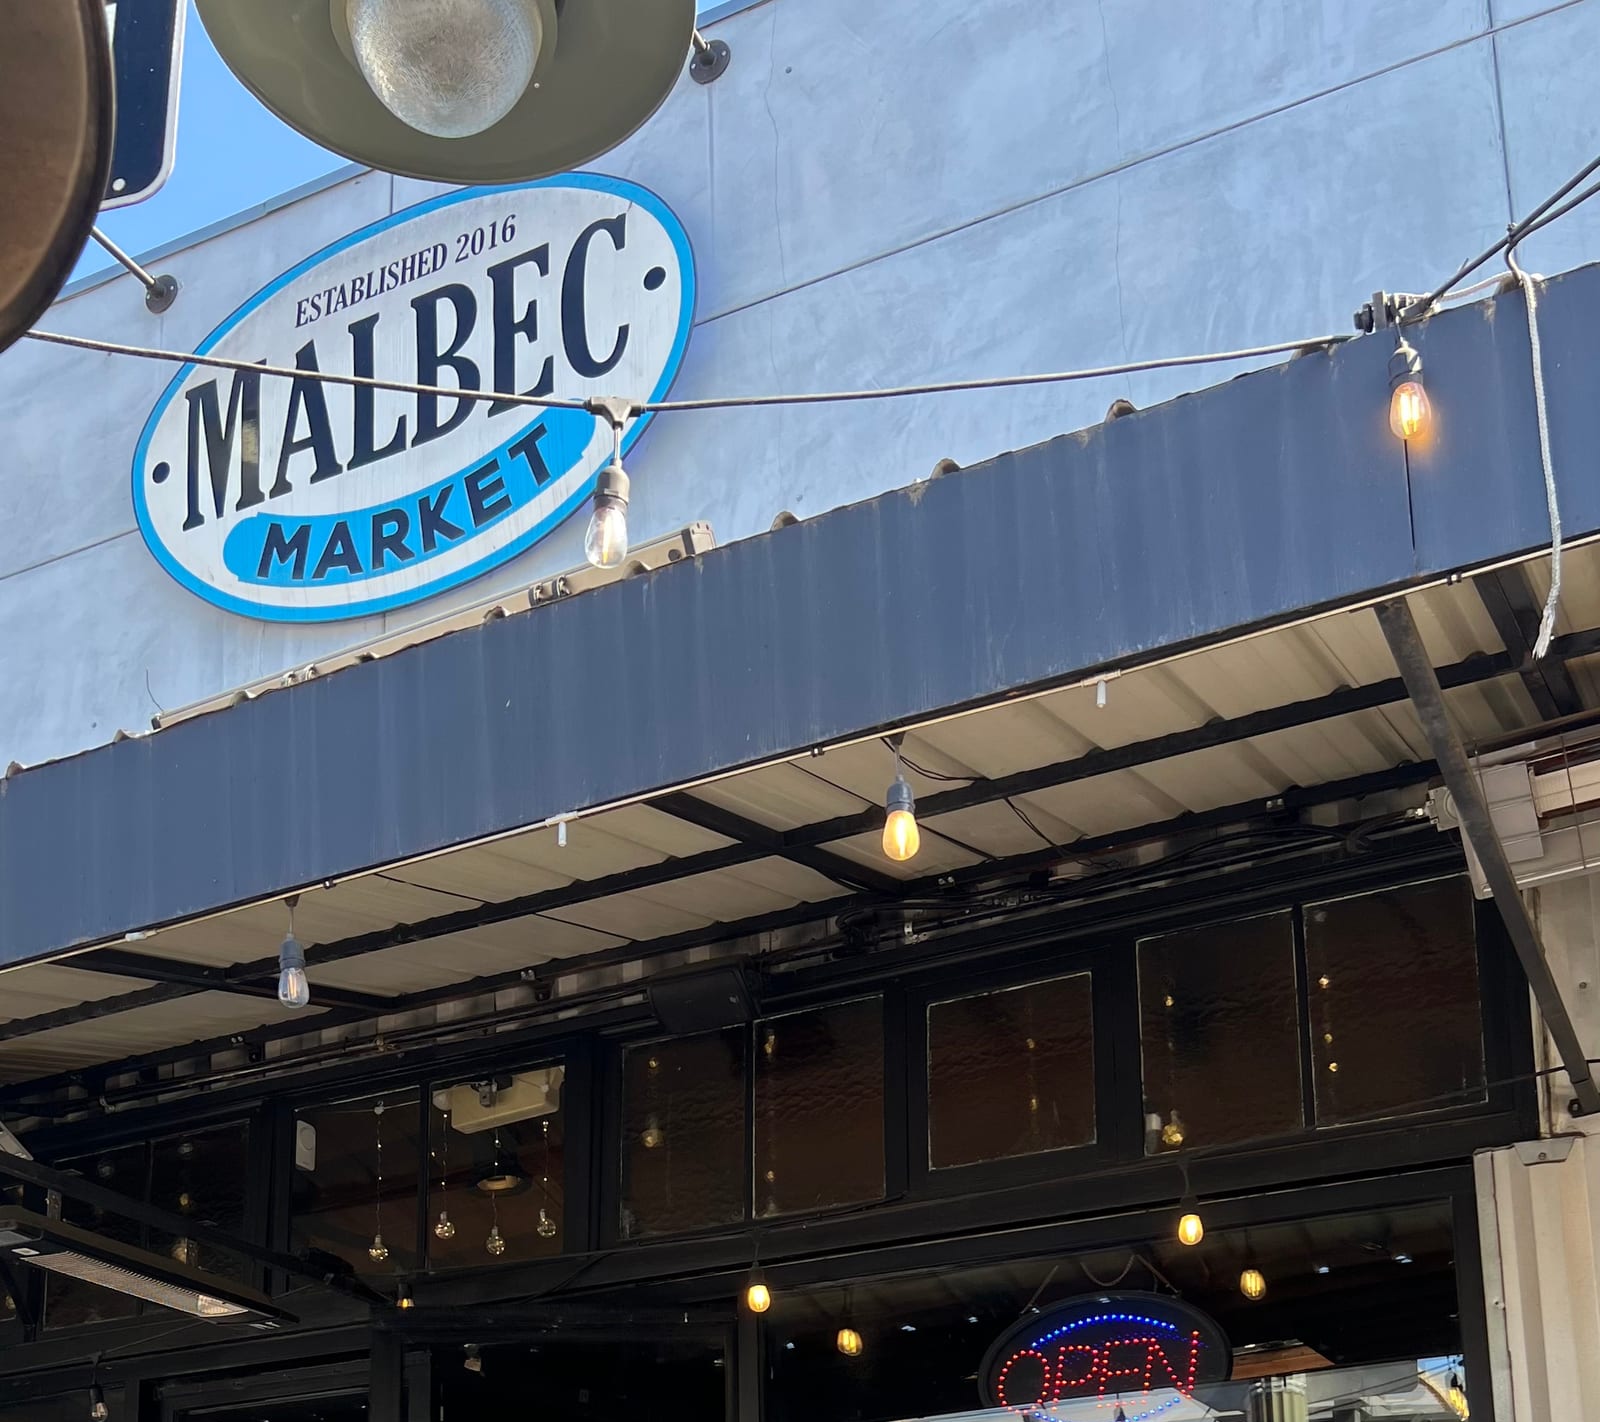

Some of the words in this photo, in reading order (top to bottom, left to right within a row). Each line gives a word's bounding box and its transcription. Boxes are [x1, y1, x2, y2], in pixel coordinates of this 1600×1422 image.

[294, 242, 447, 328] ESTABLISHED
[455, 213, 516, 264] 2016
[182, 213, 630, 532] MALBEC
[257, 422, 549, 580] MARKET
[997, 1329, 1200, 1415] OPEN
